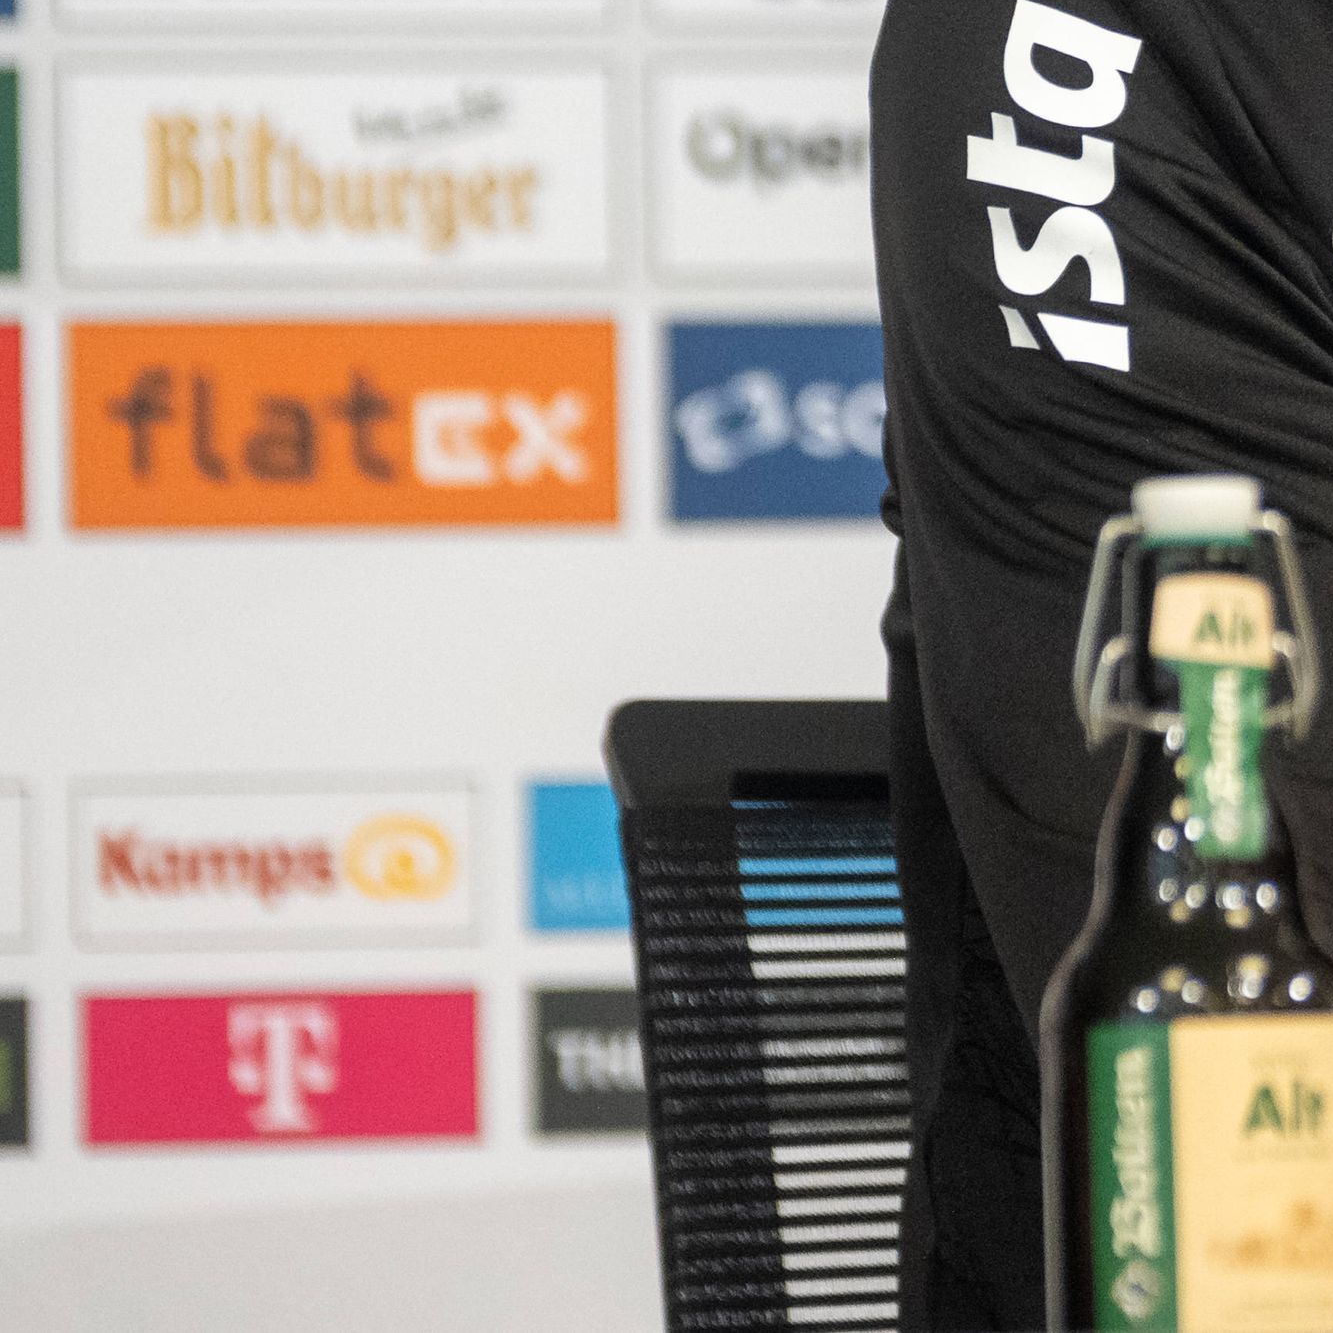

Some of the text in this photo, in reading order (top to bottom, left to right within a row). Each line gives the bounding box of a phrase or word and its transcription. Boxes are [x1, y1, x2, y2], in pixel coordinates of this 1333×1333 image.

[145, 111, 542, 252] Bitburger
[92, 824, 338, 914] Kamps
[1240, 1074, 1330, 1138] Alt
